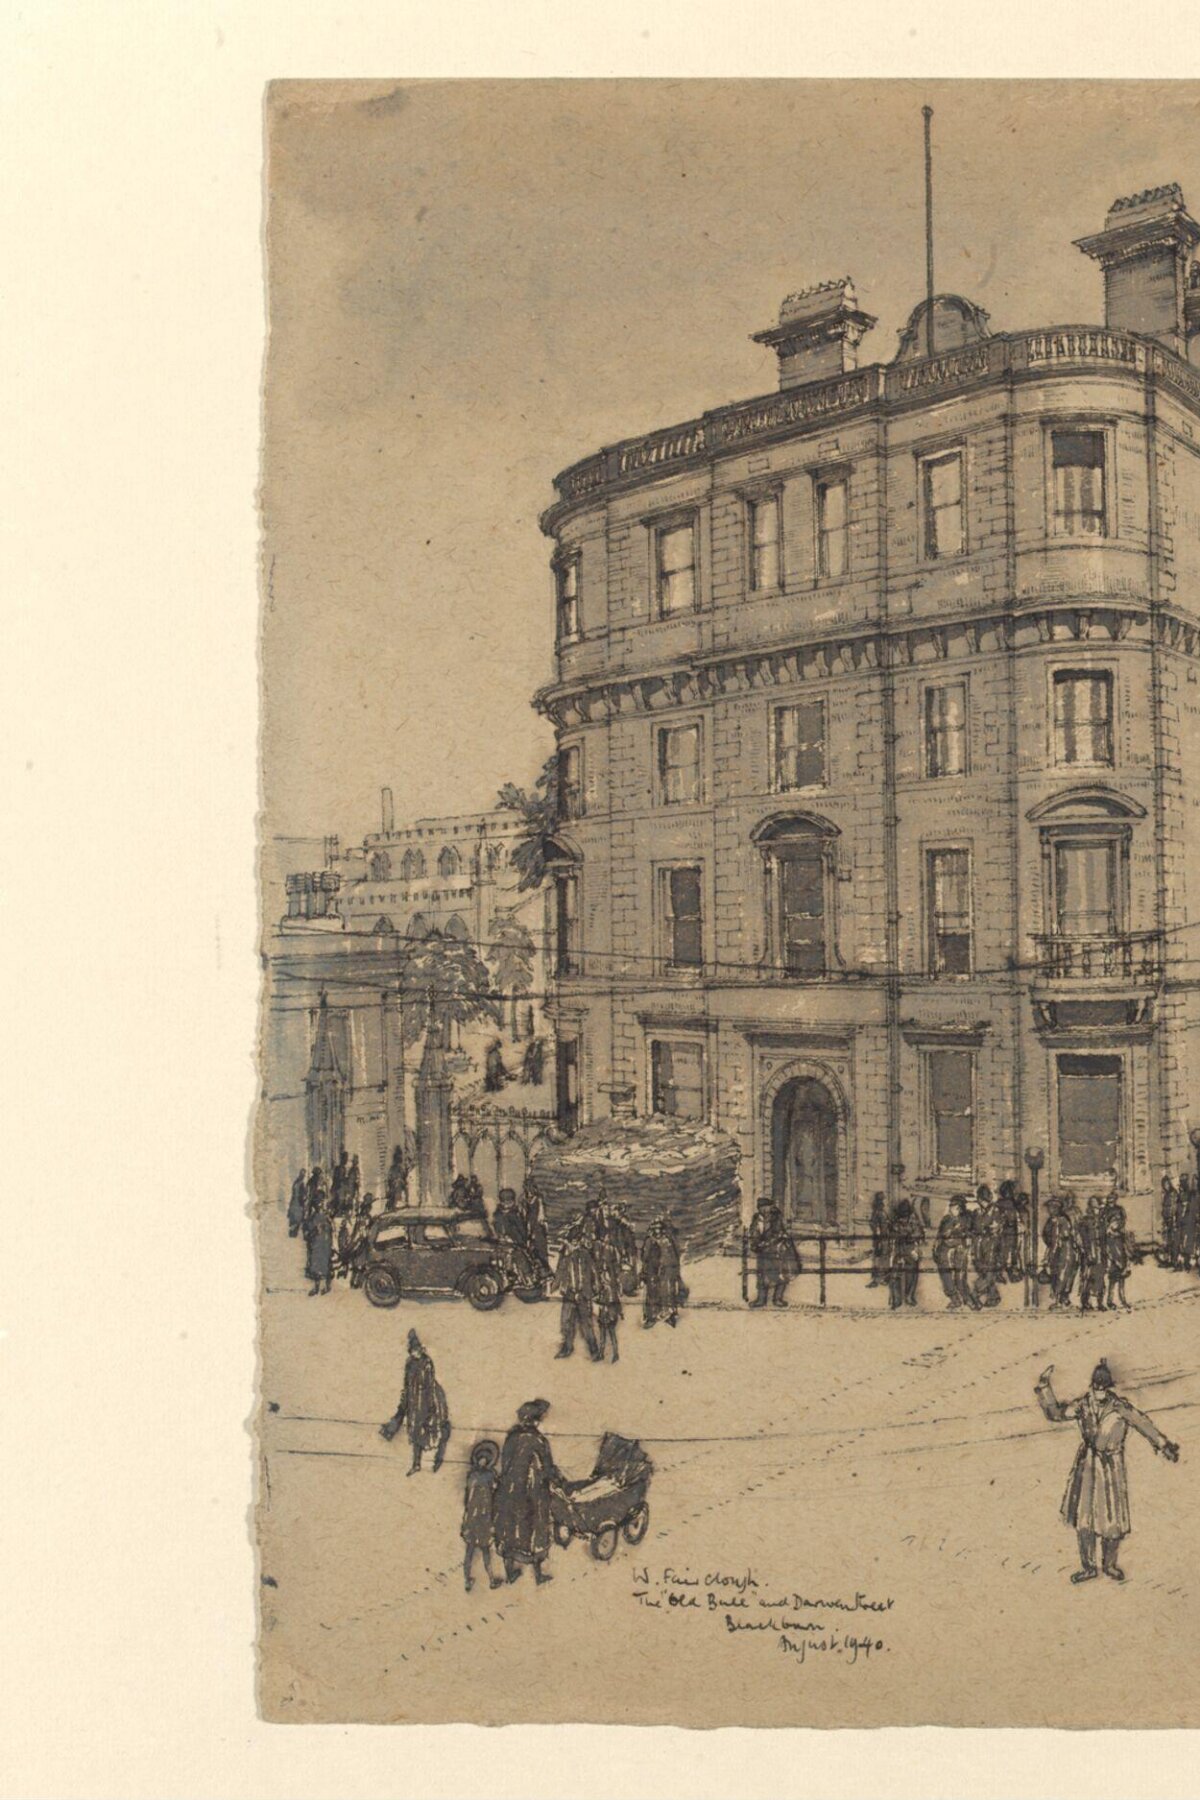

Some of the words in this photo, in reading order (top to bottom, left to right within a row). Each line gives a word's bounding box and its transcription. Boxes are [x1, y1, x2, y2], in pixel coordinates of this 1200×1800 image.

[632, 1566, 660, 1586] W.
[632, 1591, 662, 1609] The
[759, 1596, 789, 1609] and
[792, 1593, 852, 1611] Darwen
